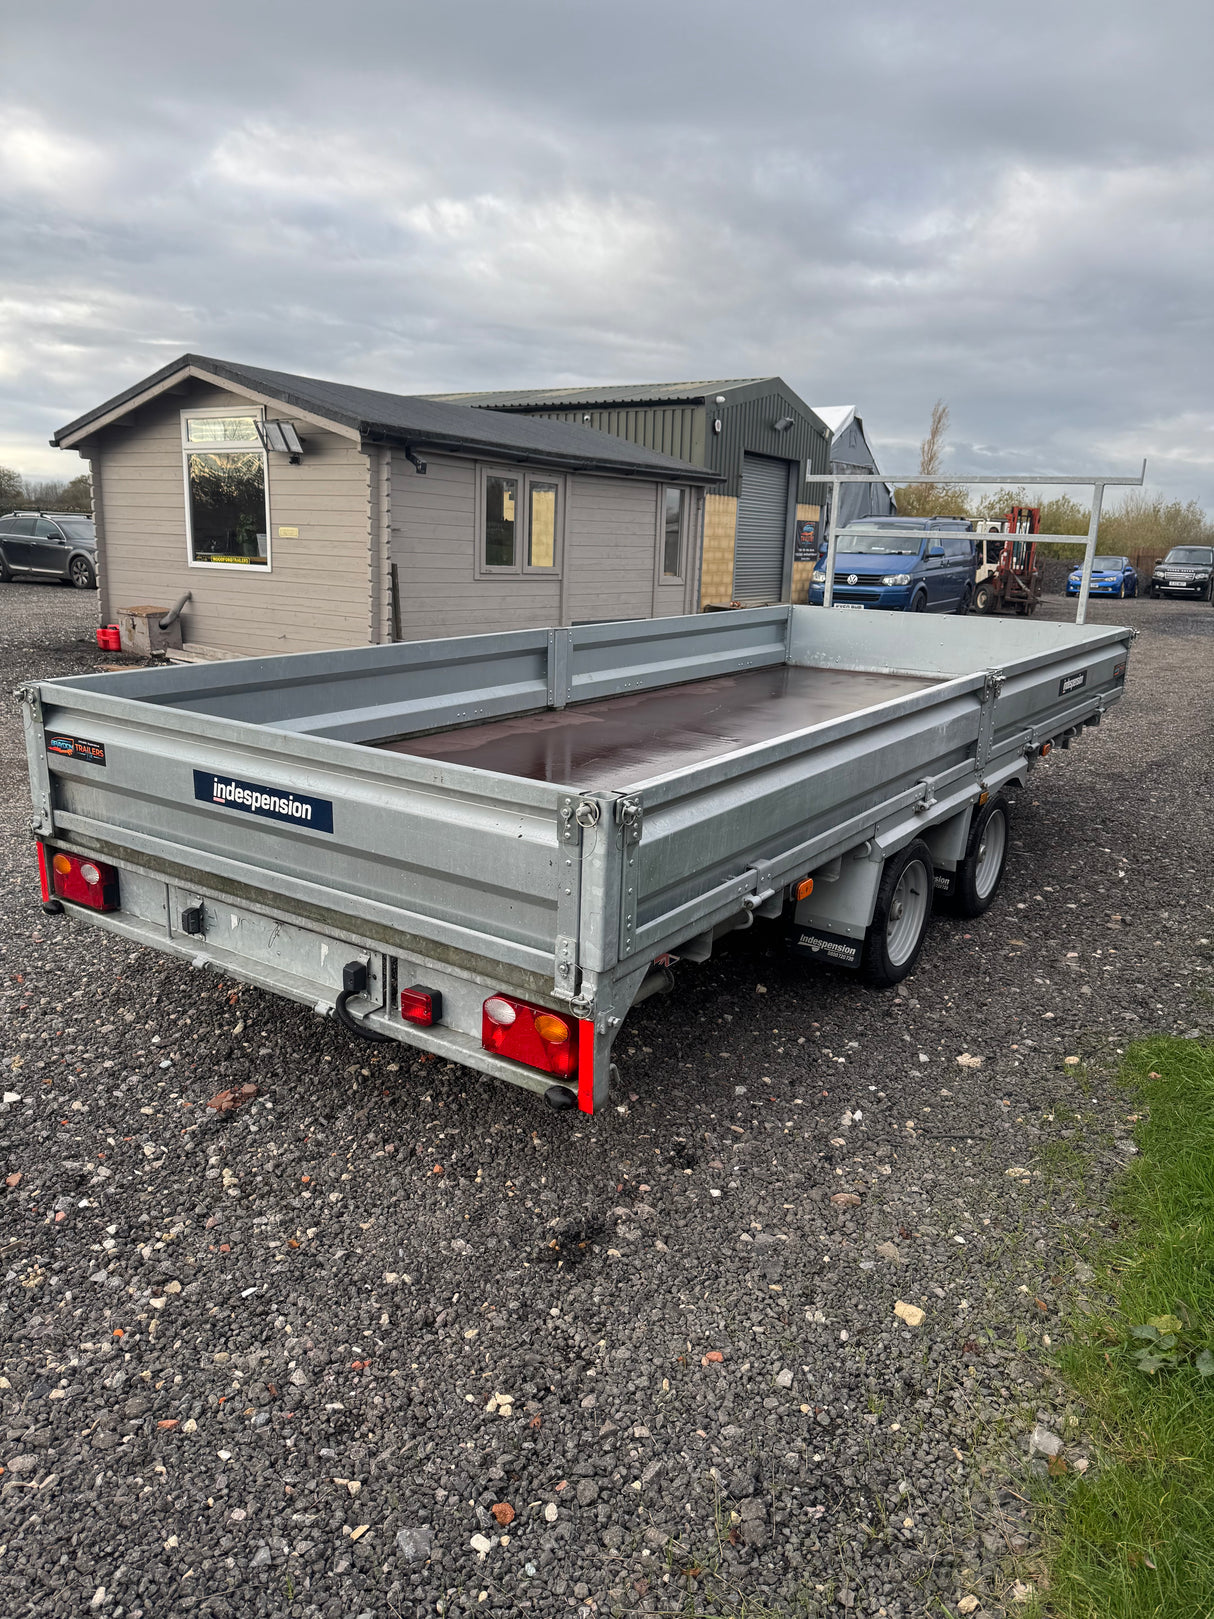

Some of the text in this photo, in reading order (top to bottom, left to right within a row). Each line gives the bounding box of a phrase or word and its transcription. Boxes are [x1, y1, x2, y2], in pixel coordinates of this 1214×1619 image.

[75, 743, 104, 758] TRAILERS
[213, 777, 312, 820] indespension
[799, 934, 857, 955] Indespension
